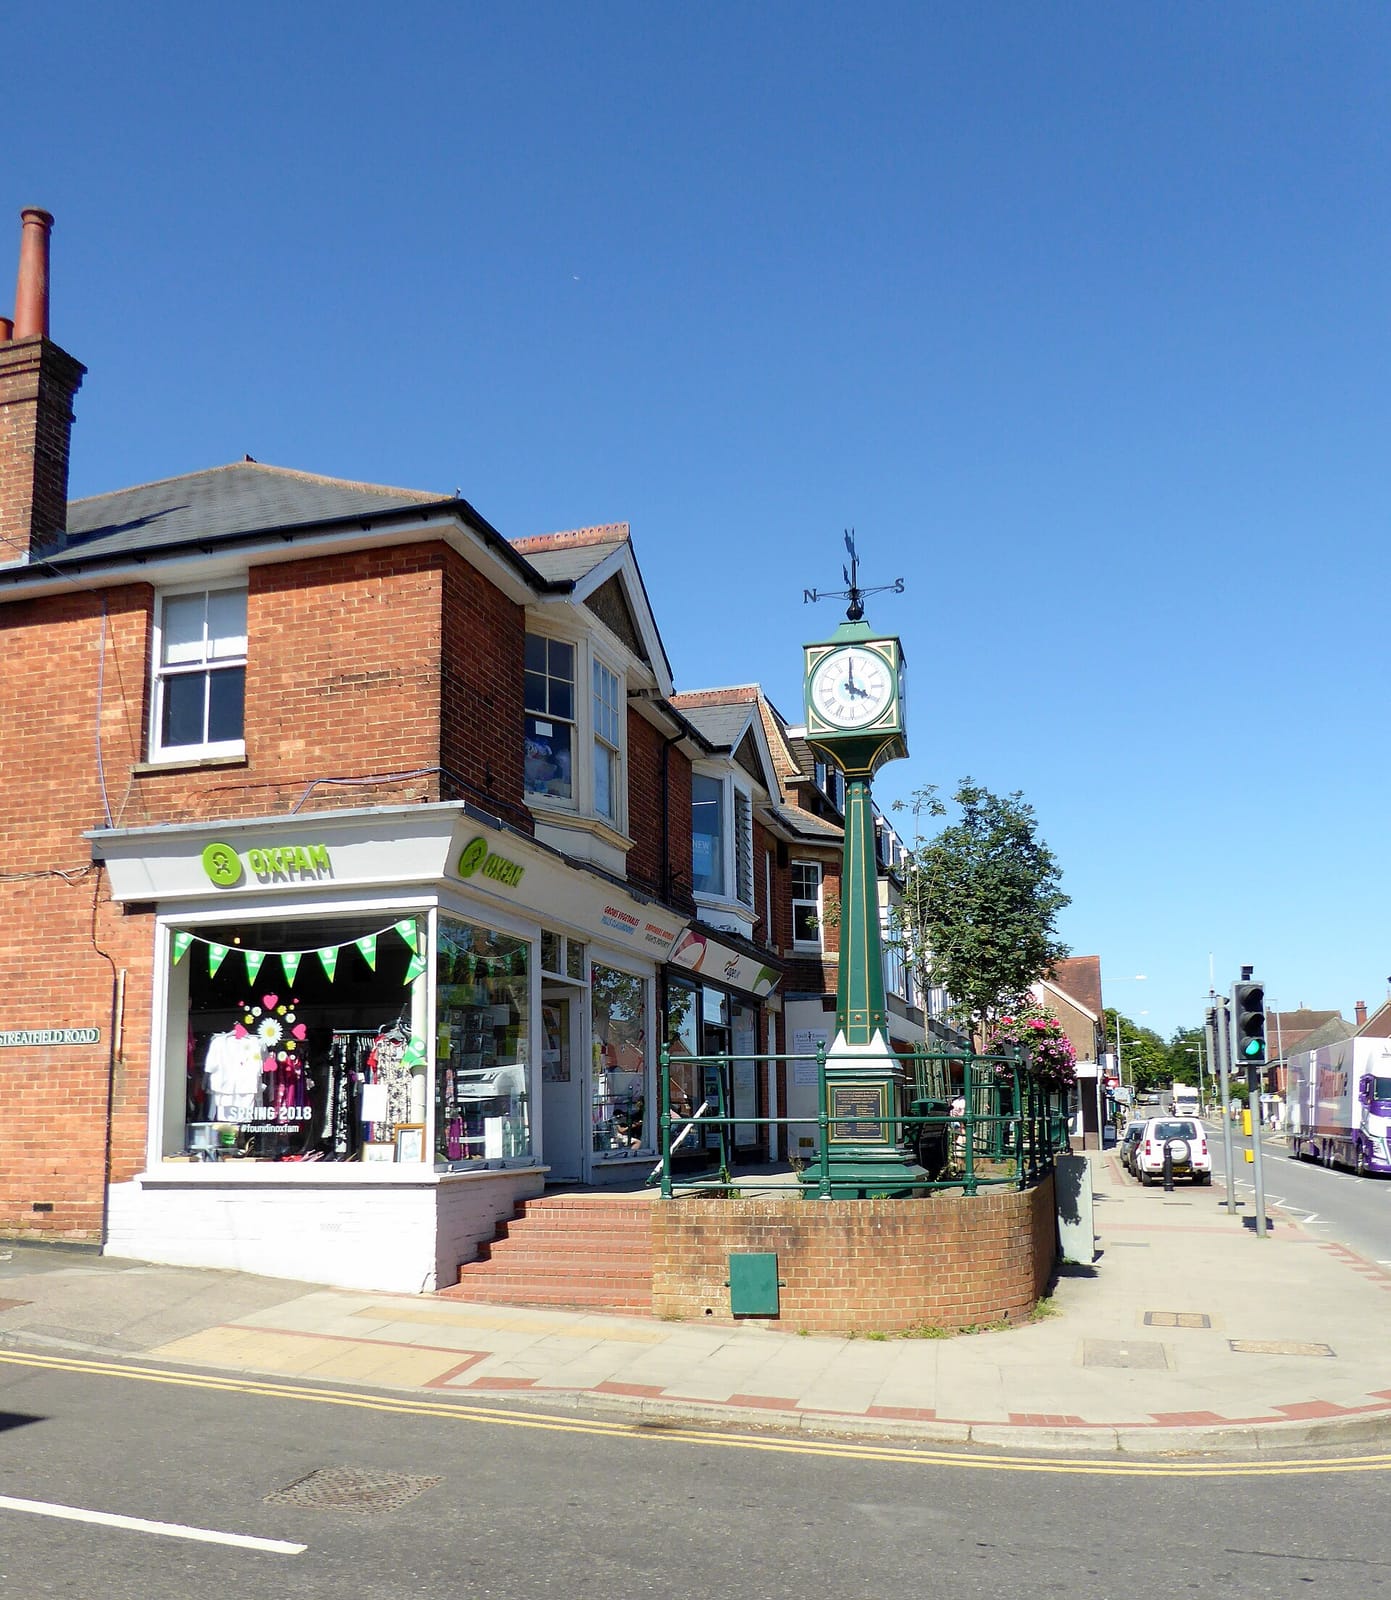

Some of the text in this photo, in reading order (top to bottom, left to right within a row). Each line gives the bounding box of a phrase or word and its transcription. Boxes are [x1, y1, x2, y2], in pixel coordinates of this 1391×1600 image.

[895, 578, 905, 593] S
[803, 588, 817, 604] N
[248, 844, 331, 873] OXFAM
[482, 853, 525, 888] OXFAM
[0, 1030, 96, 1044] STREATFIELD ROAD
[230, 1106, 312, 1120] SPRING 2018
